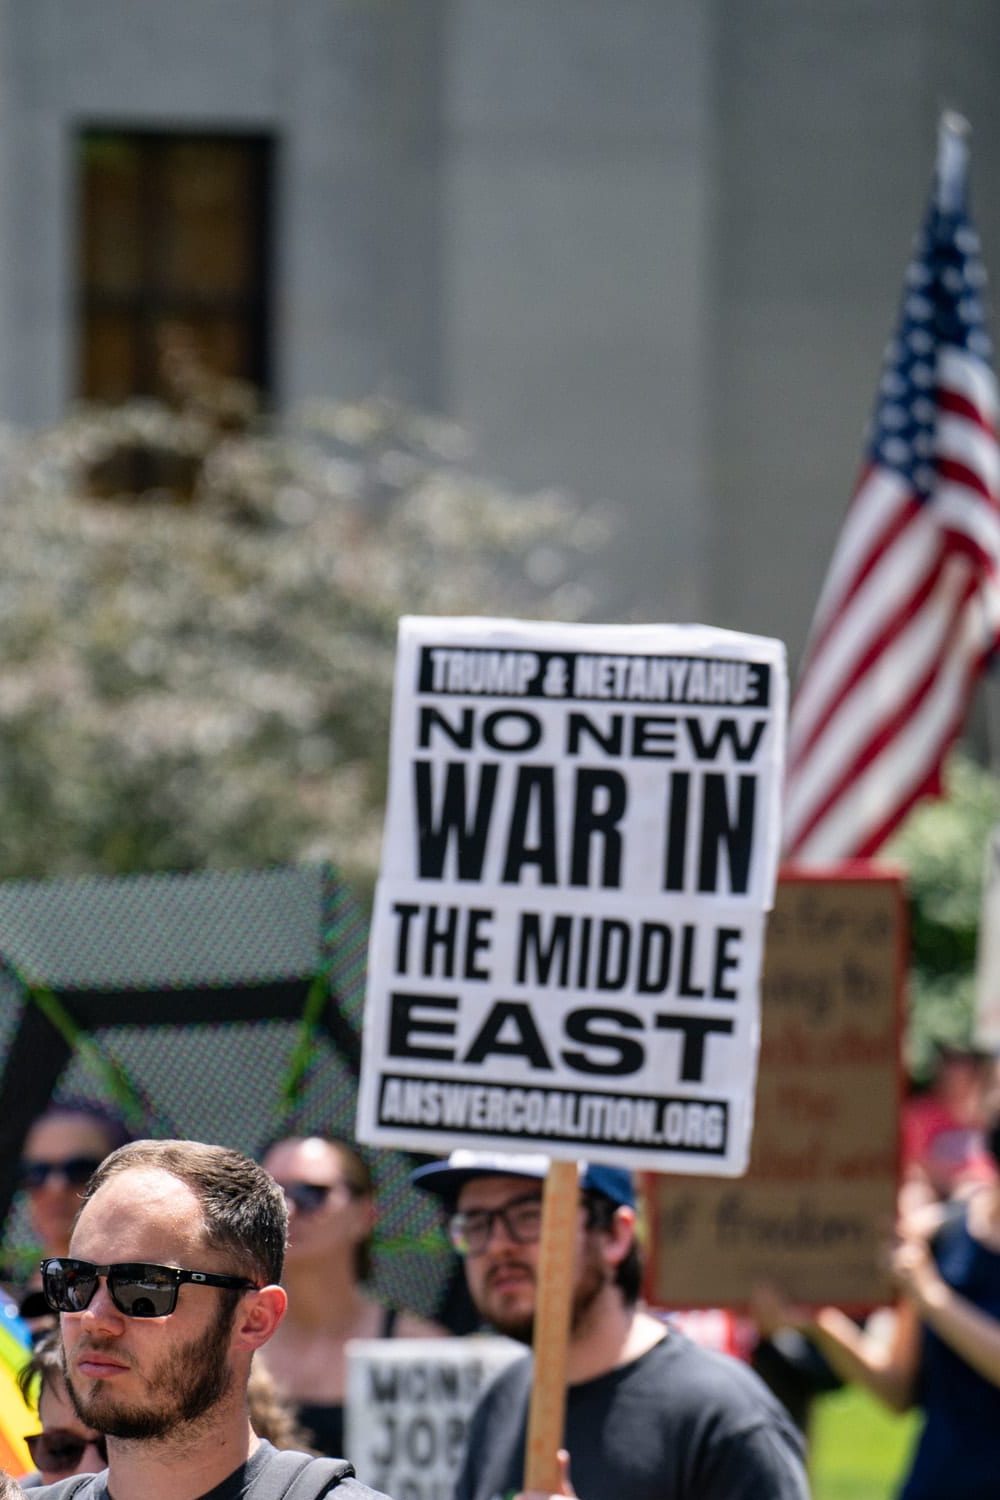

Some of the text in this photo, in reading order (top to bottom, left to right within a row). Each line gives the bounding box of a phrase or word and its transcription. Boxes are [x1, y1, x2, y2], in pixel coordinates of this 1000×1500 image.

[430, 649, 760, 703] TRUMP & NETANYAHU:
[417, 707, 767, 762] NO NEW
[412, 760, 757, 895] WAR IN
[393, 903, 495, 982] THE
[515, 911, 742, 1001] MIDDLE
[386, 993, 735, 1084] EAST
[380, 1079, 725, 1148] ANSWERCOALITION.ORG
